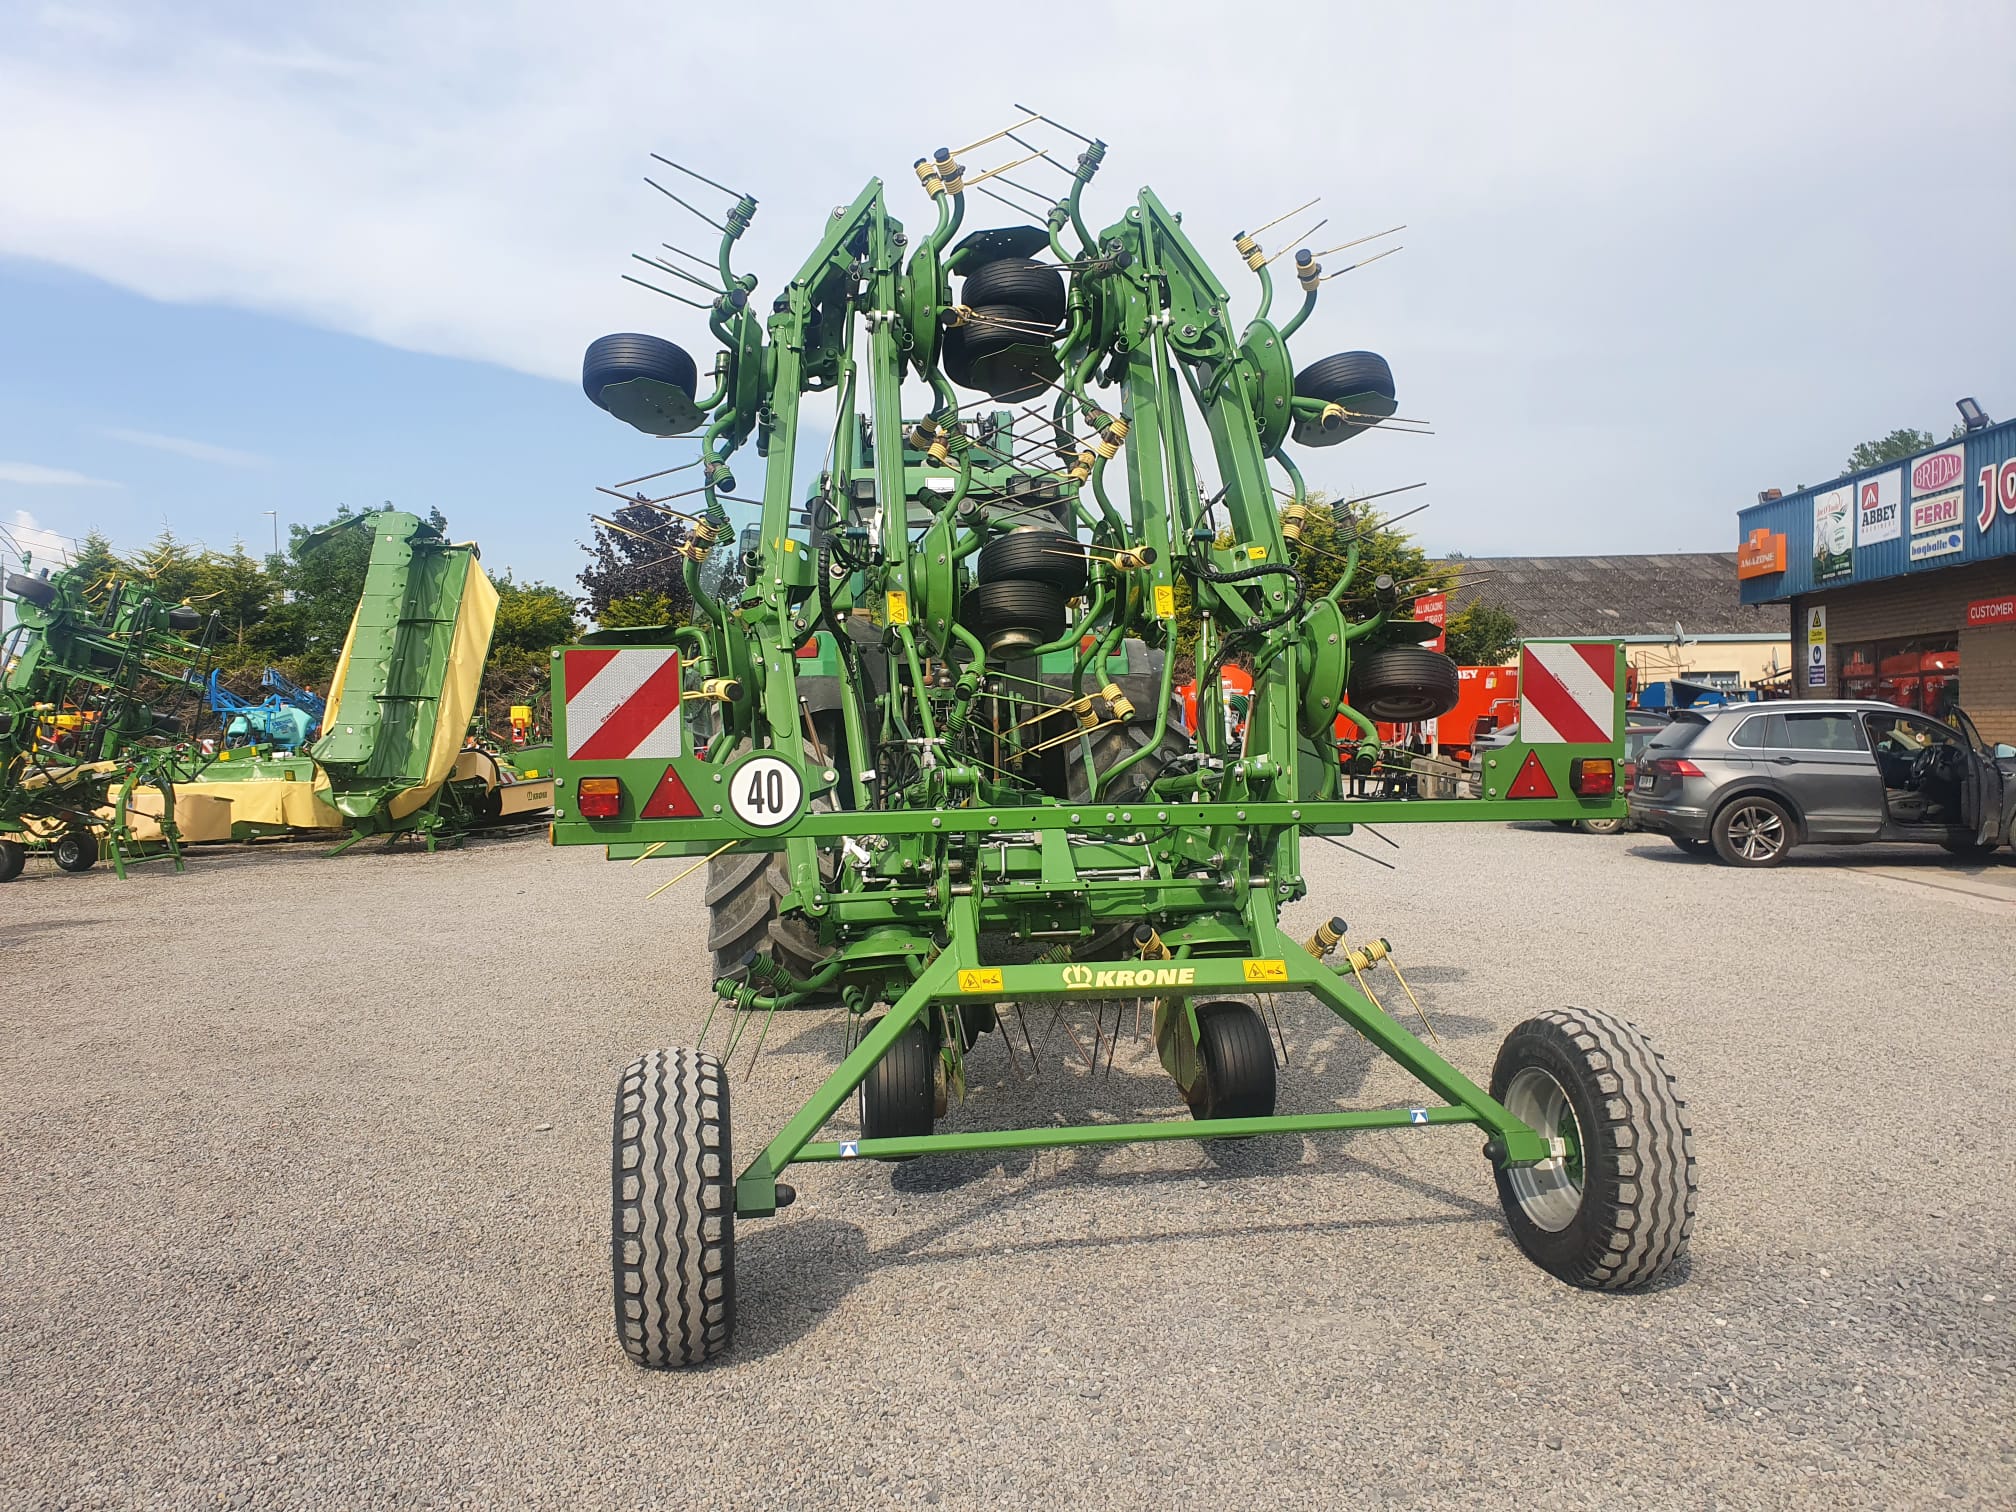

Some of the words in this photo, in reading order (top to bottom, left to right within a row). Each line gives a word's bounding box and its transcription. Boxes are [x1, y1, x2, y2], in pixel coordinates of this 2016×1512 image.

[1915, 456, 1960, 488] BREDAL
[1862, 503, 1897, 527] ABBEY
[1915, 499, 1957, 527] FERRI
[1740, 552, 1775, 568] AMAZONE
[1970, 602, 2014, 620] CUSTOMER
[747, 769, 783, 814] 40
[1095, 967, 1195, 988] KRONE
